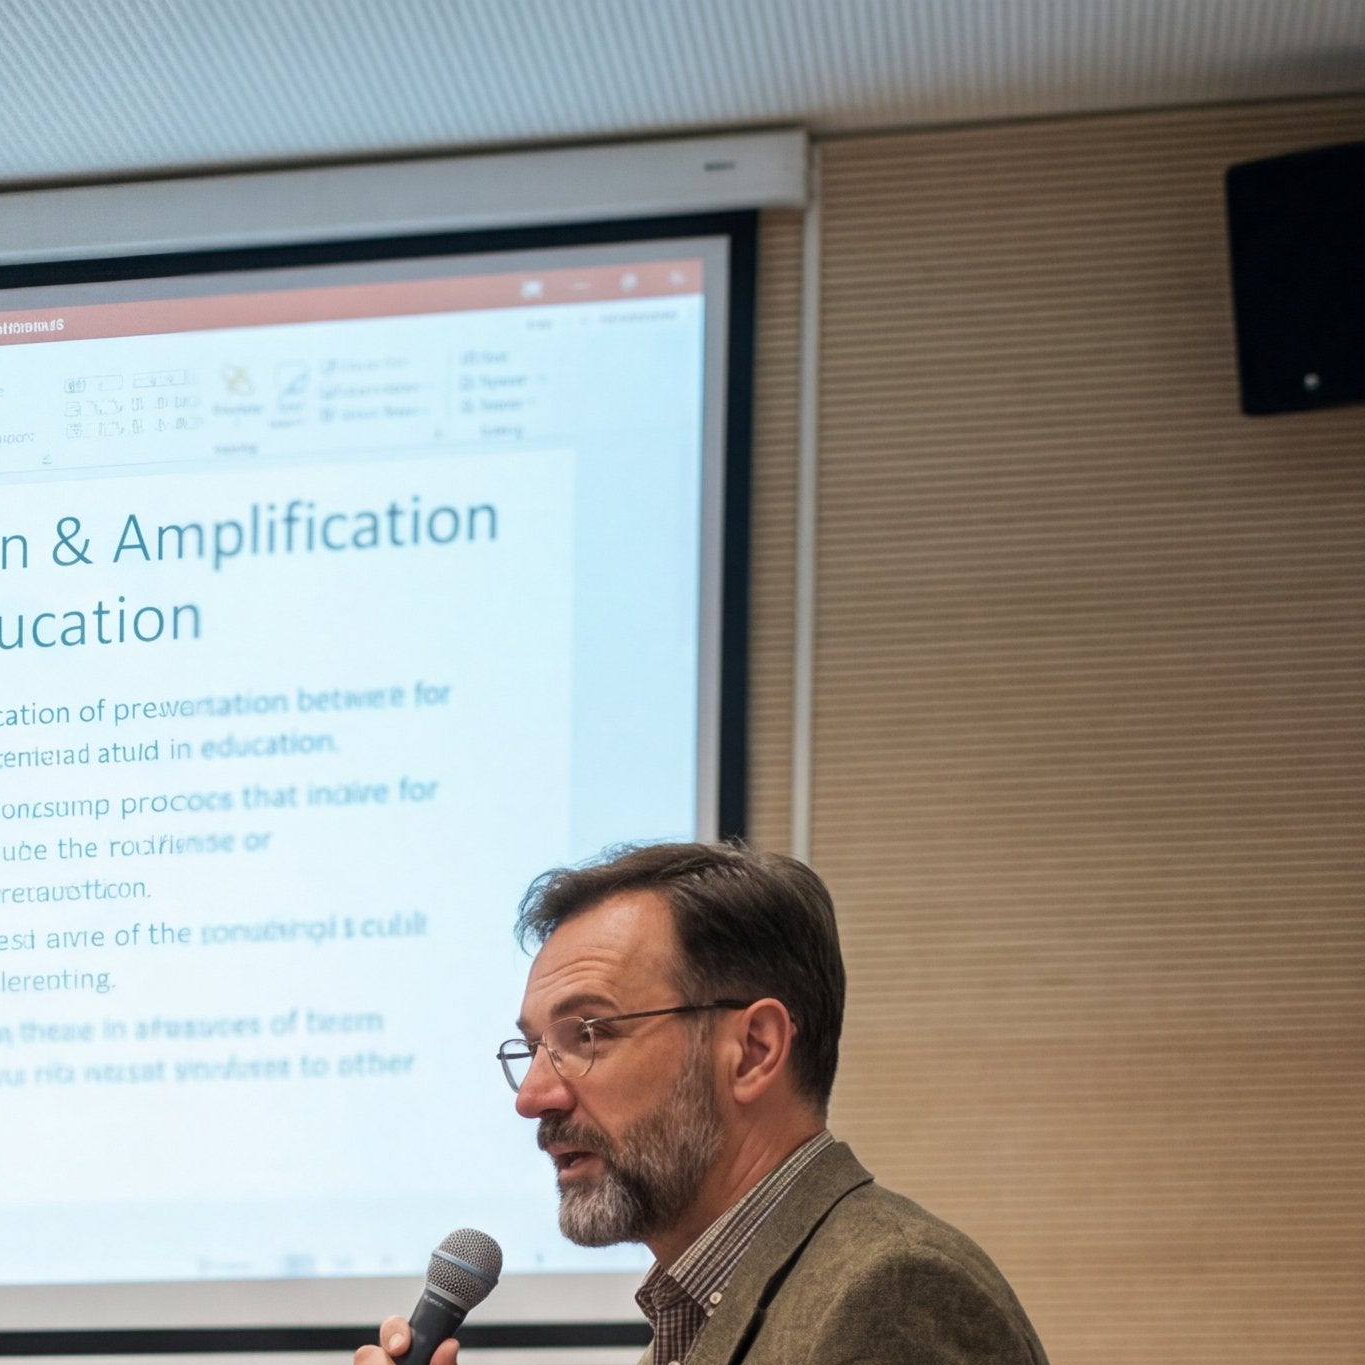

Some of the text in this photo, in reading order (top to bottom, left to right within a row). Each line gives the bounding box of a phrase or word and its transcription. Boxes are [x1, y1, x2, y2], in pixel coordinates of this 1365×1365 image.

[52, 516, 93, 566] &
[113, 496, 499, 572] Amplification
[79, 699, 105, 723] of
[414, 679, 453, 708] for
[171, 738, 191, 760] in
[398, 774, 439, 802] for
[58, 837, 98, 860] the
[114, 922, 140, 946] of
[149, 922, 191, 945] the
